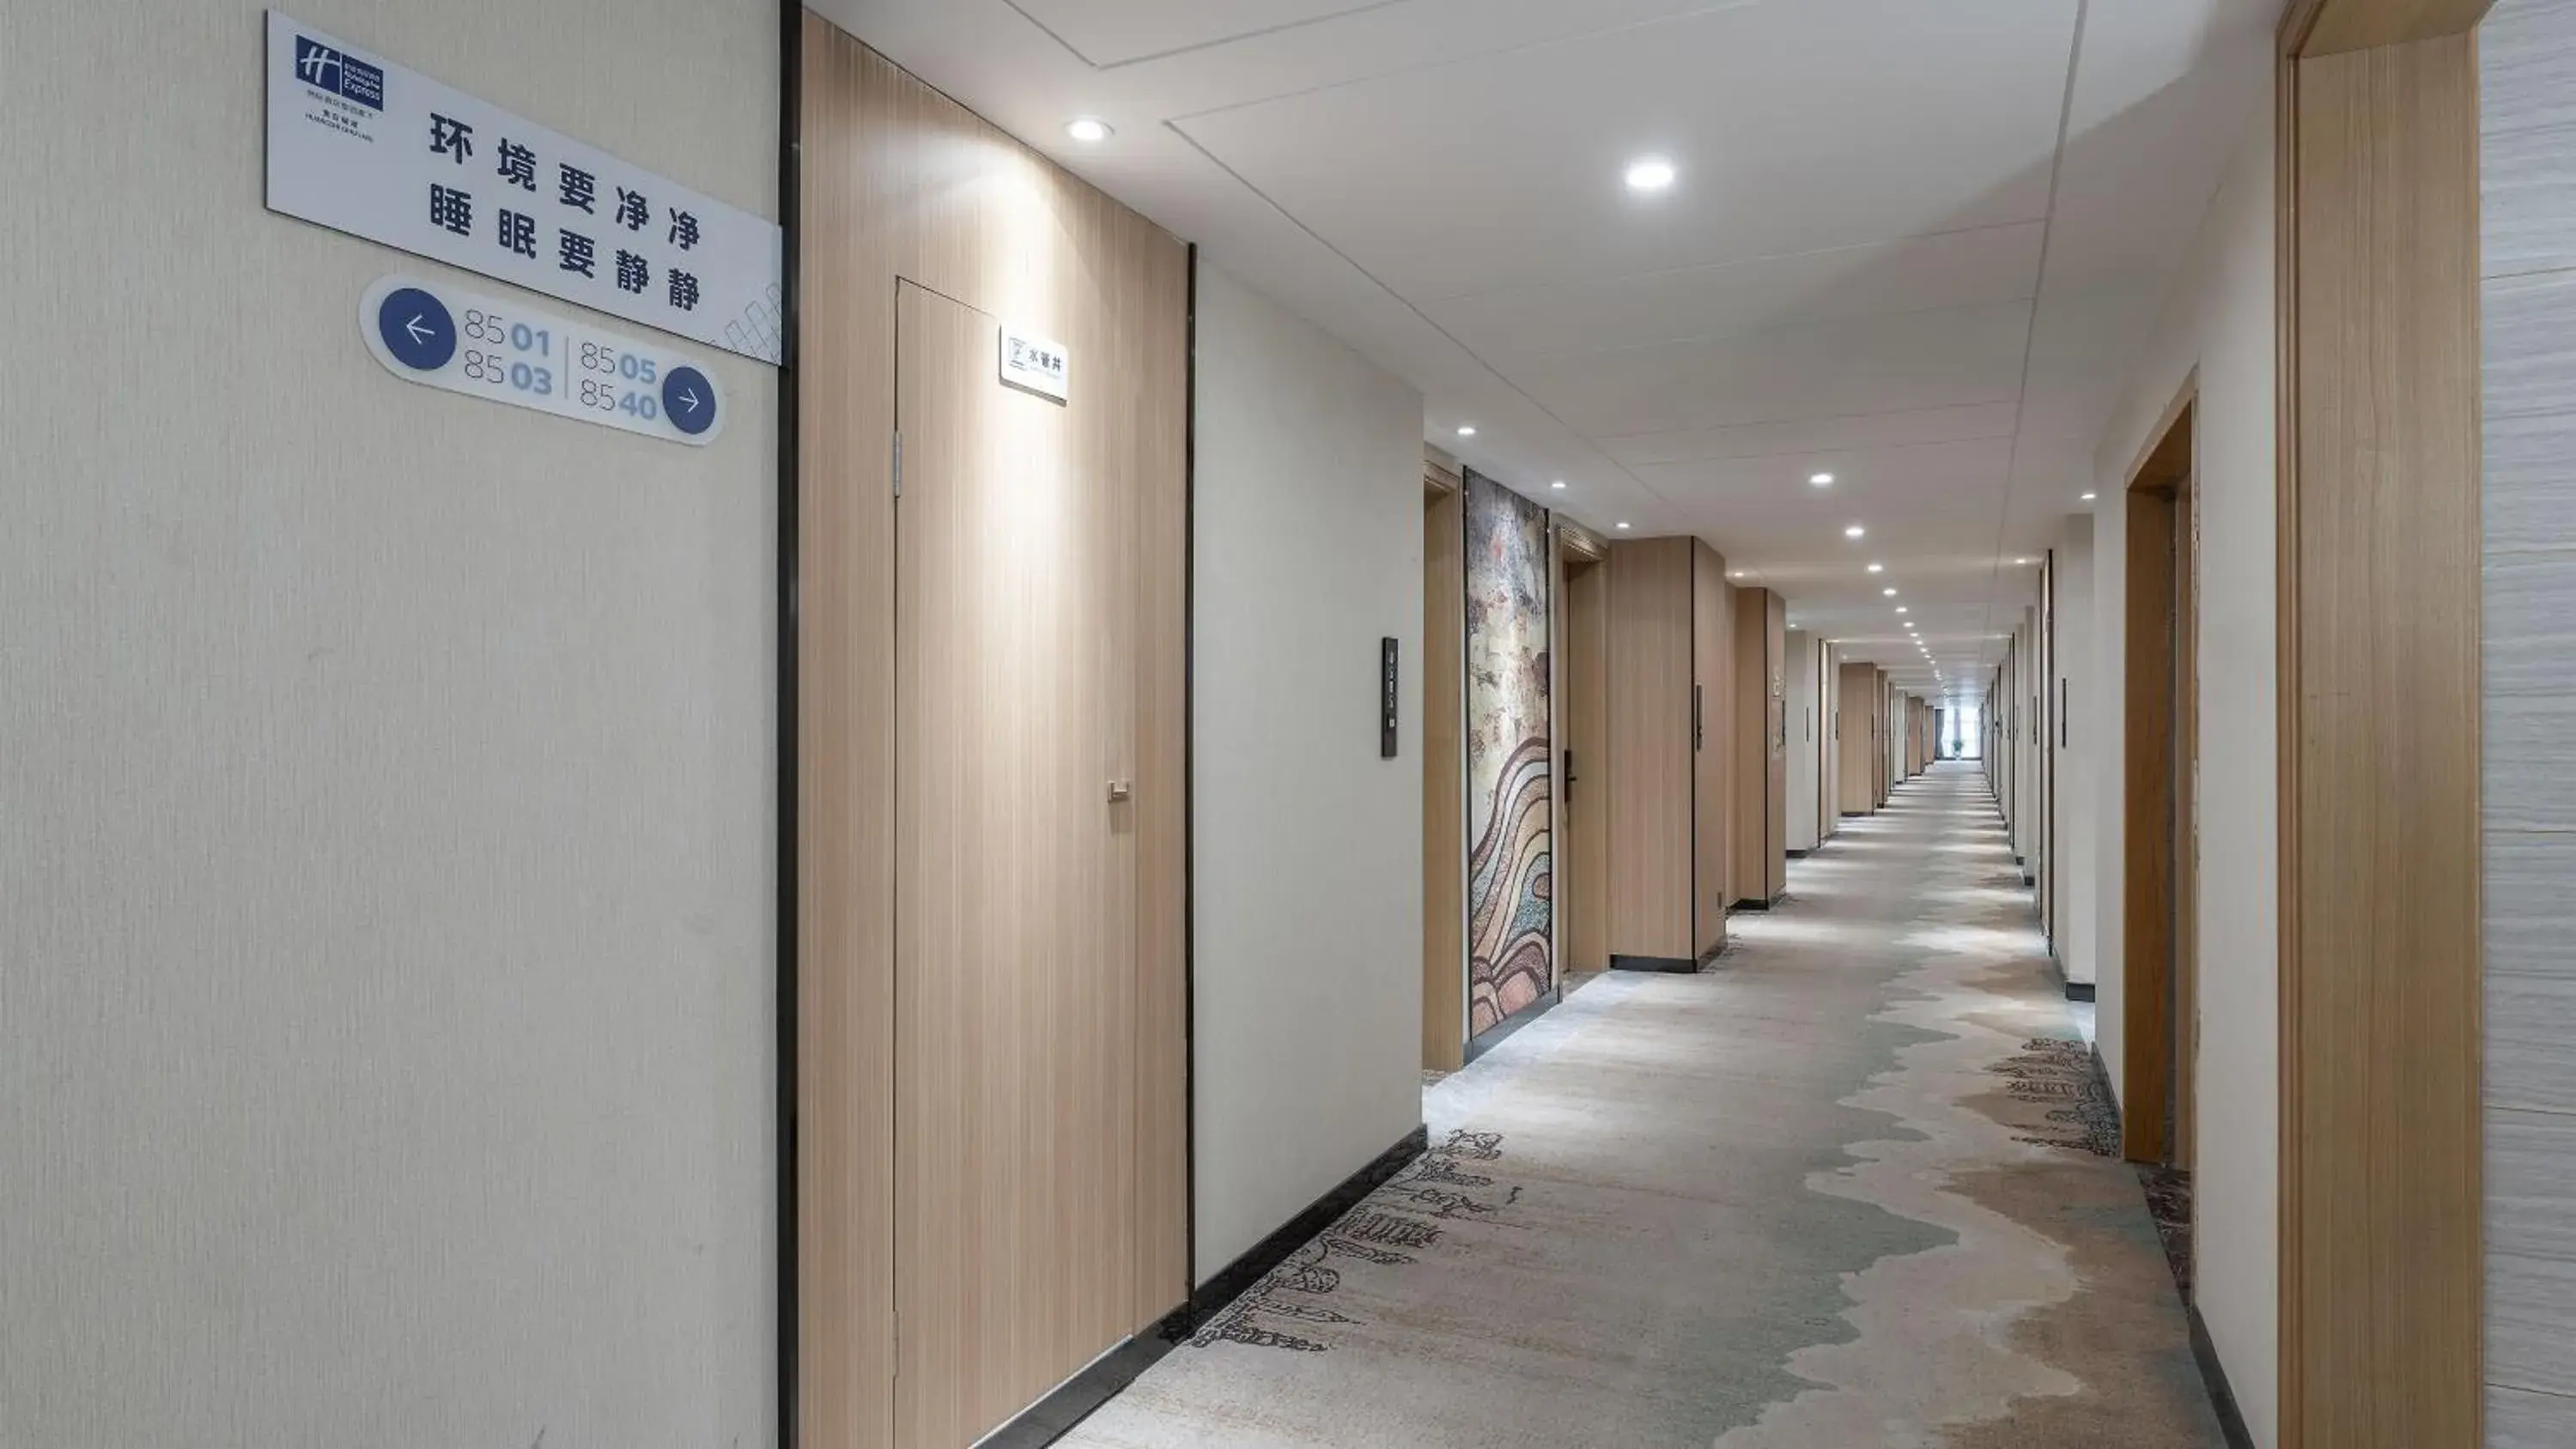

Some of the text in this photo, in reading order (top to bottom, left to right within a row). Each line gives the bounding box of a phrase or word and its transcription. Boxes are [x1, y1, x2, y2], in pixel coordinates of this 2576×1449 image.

[344, 78, 380, 101] Express
[429, 112, 701, 251] 环境要净净
[429, 183, 701, 311] 睡眠要静静
